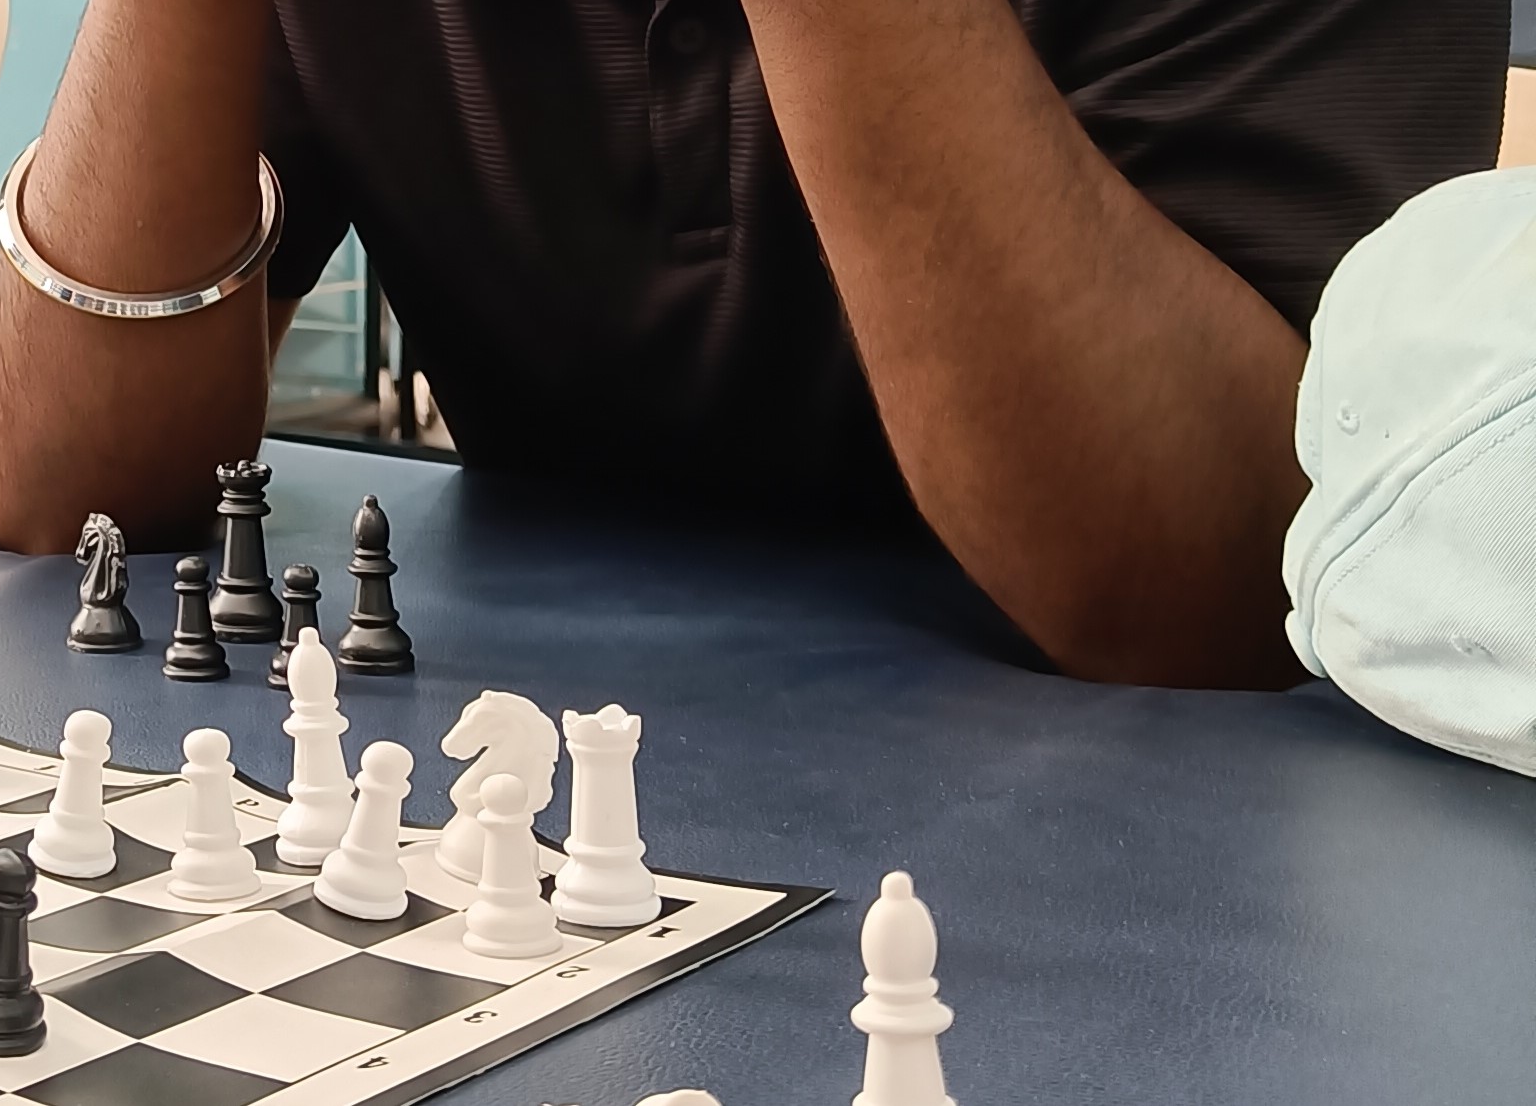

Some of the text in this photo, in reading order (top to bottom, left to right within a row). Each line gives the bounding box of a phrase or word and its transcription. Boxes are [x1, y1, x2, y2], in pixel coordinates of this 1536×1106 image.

[556, 966, 590, 979] 2
[463, 1010, 498, 1023] 3
[356, 1056, 390, 1069] 4
